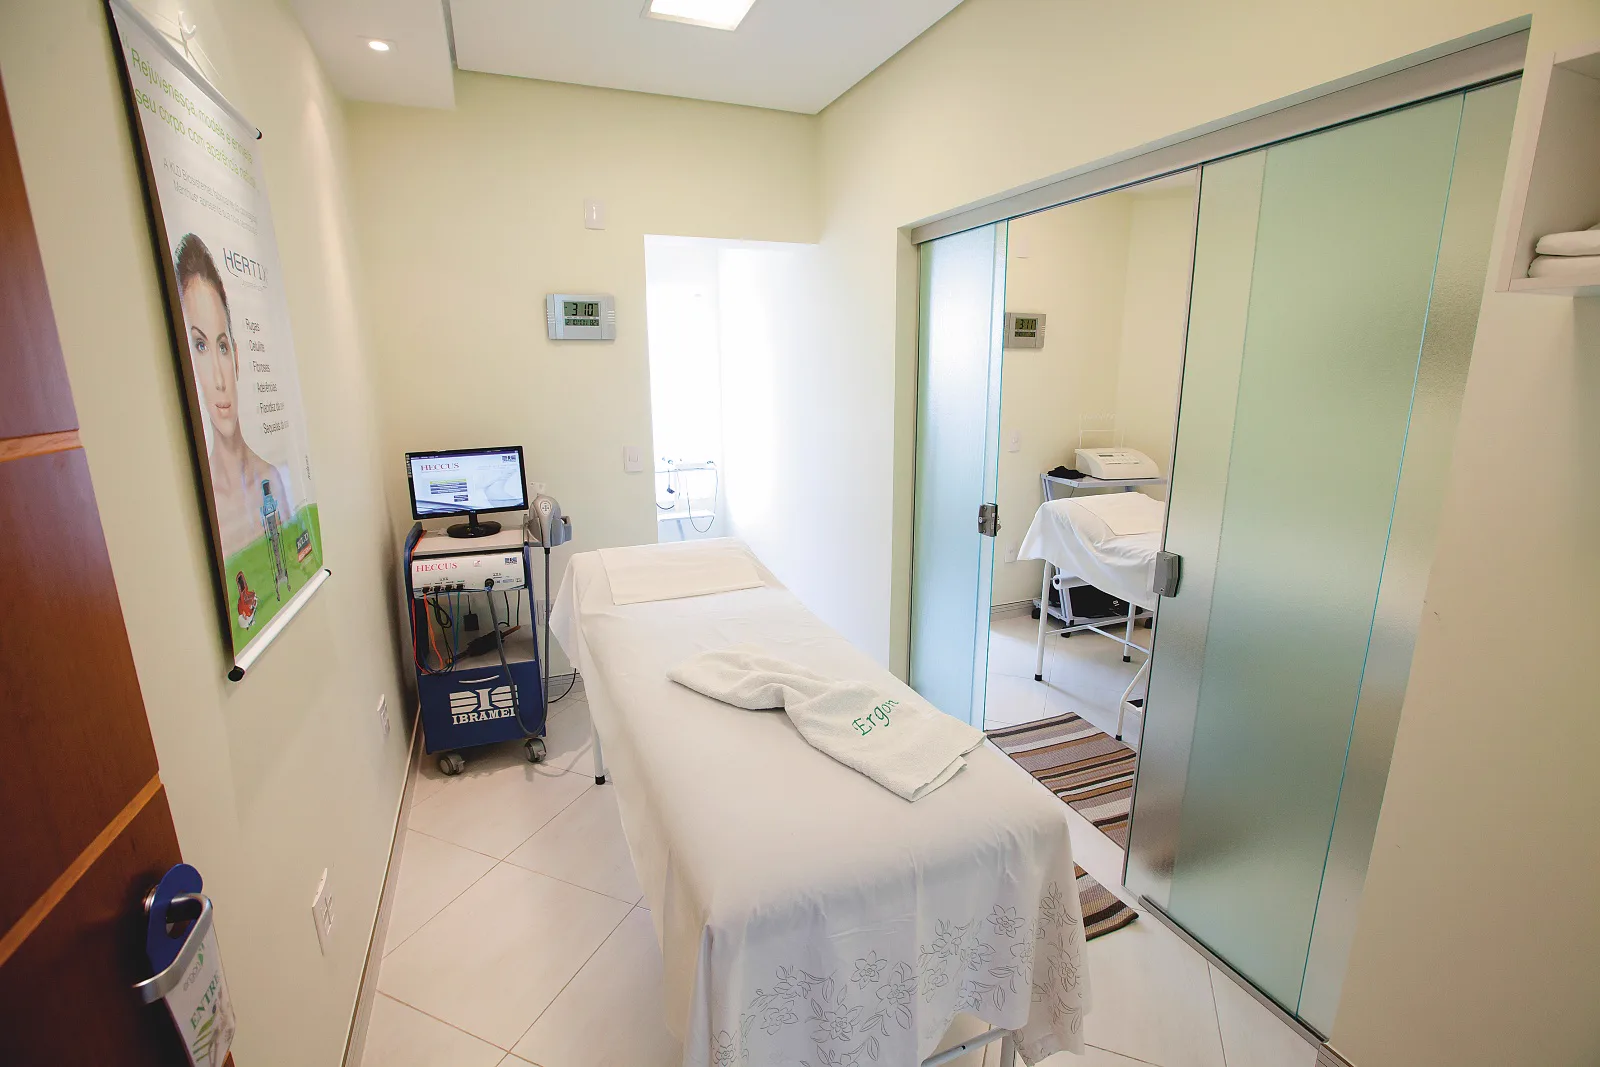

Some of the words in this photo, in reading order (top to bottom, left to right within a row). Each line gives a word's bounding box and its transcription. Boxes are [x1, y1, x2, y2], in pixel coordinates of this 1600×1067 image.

[134, 88, 157, 114] seu
[158, 105, 185, 136] corpo
[420, 462, 460, 472] HECCUS
[415, 562, 458, 573] HECCUS
[851, 699, 900, 736] Ergon
